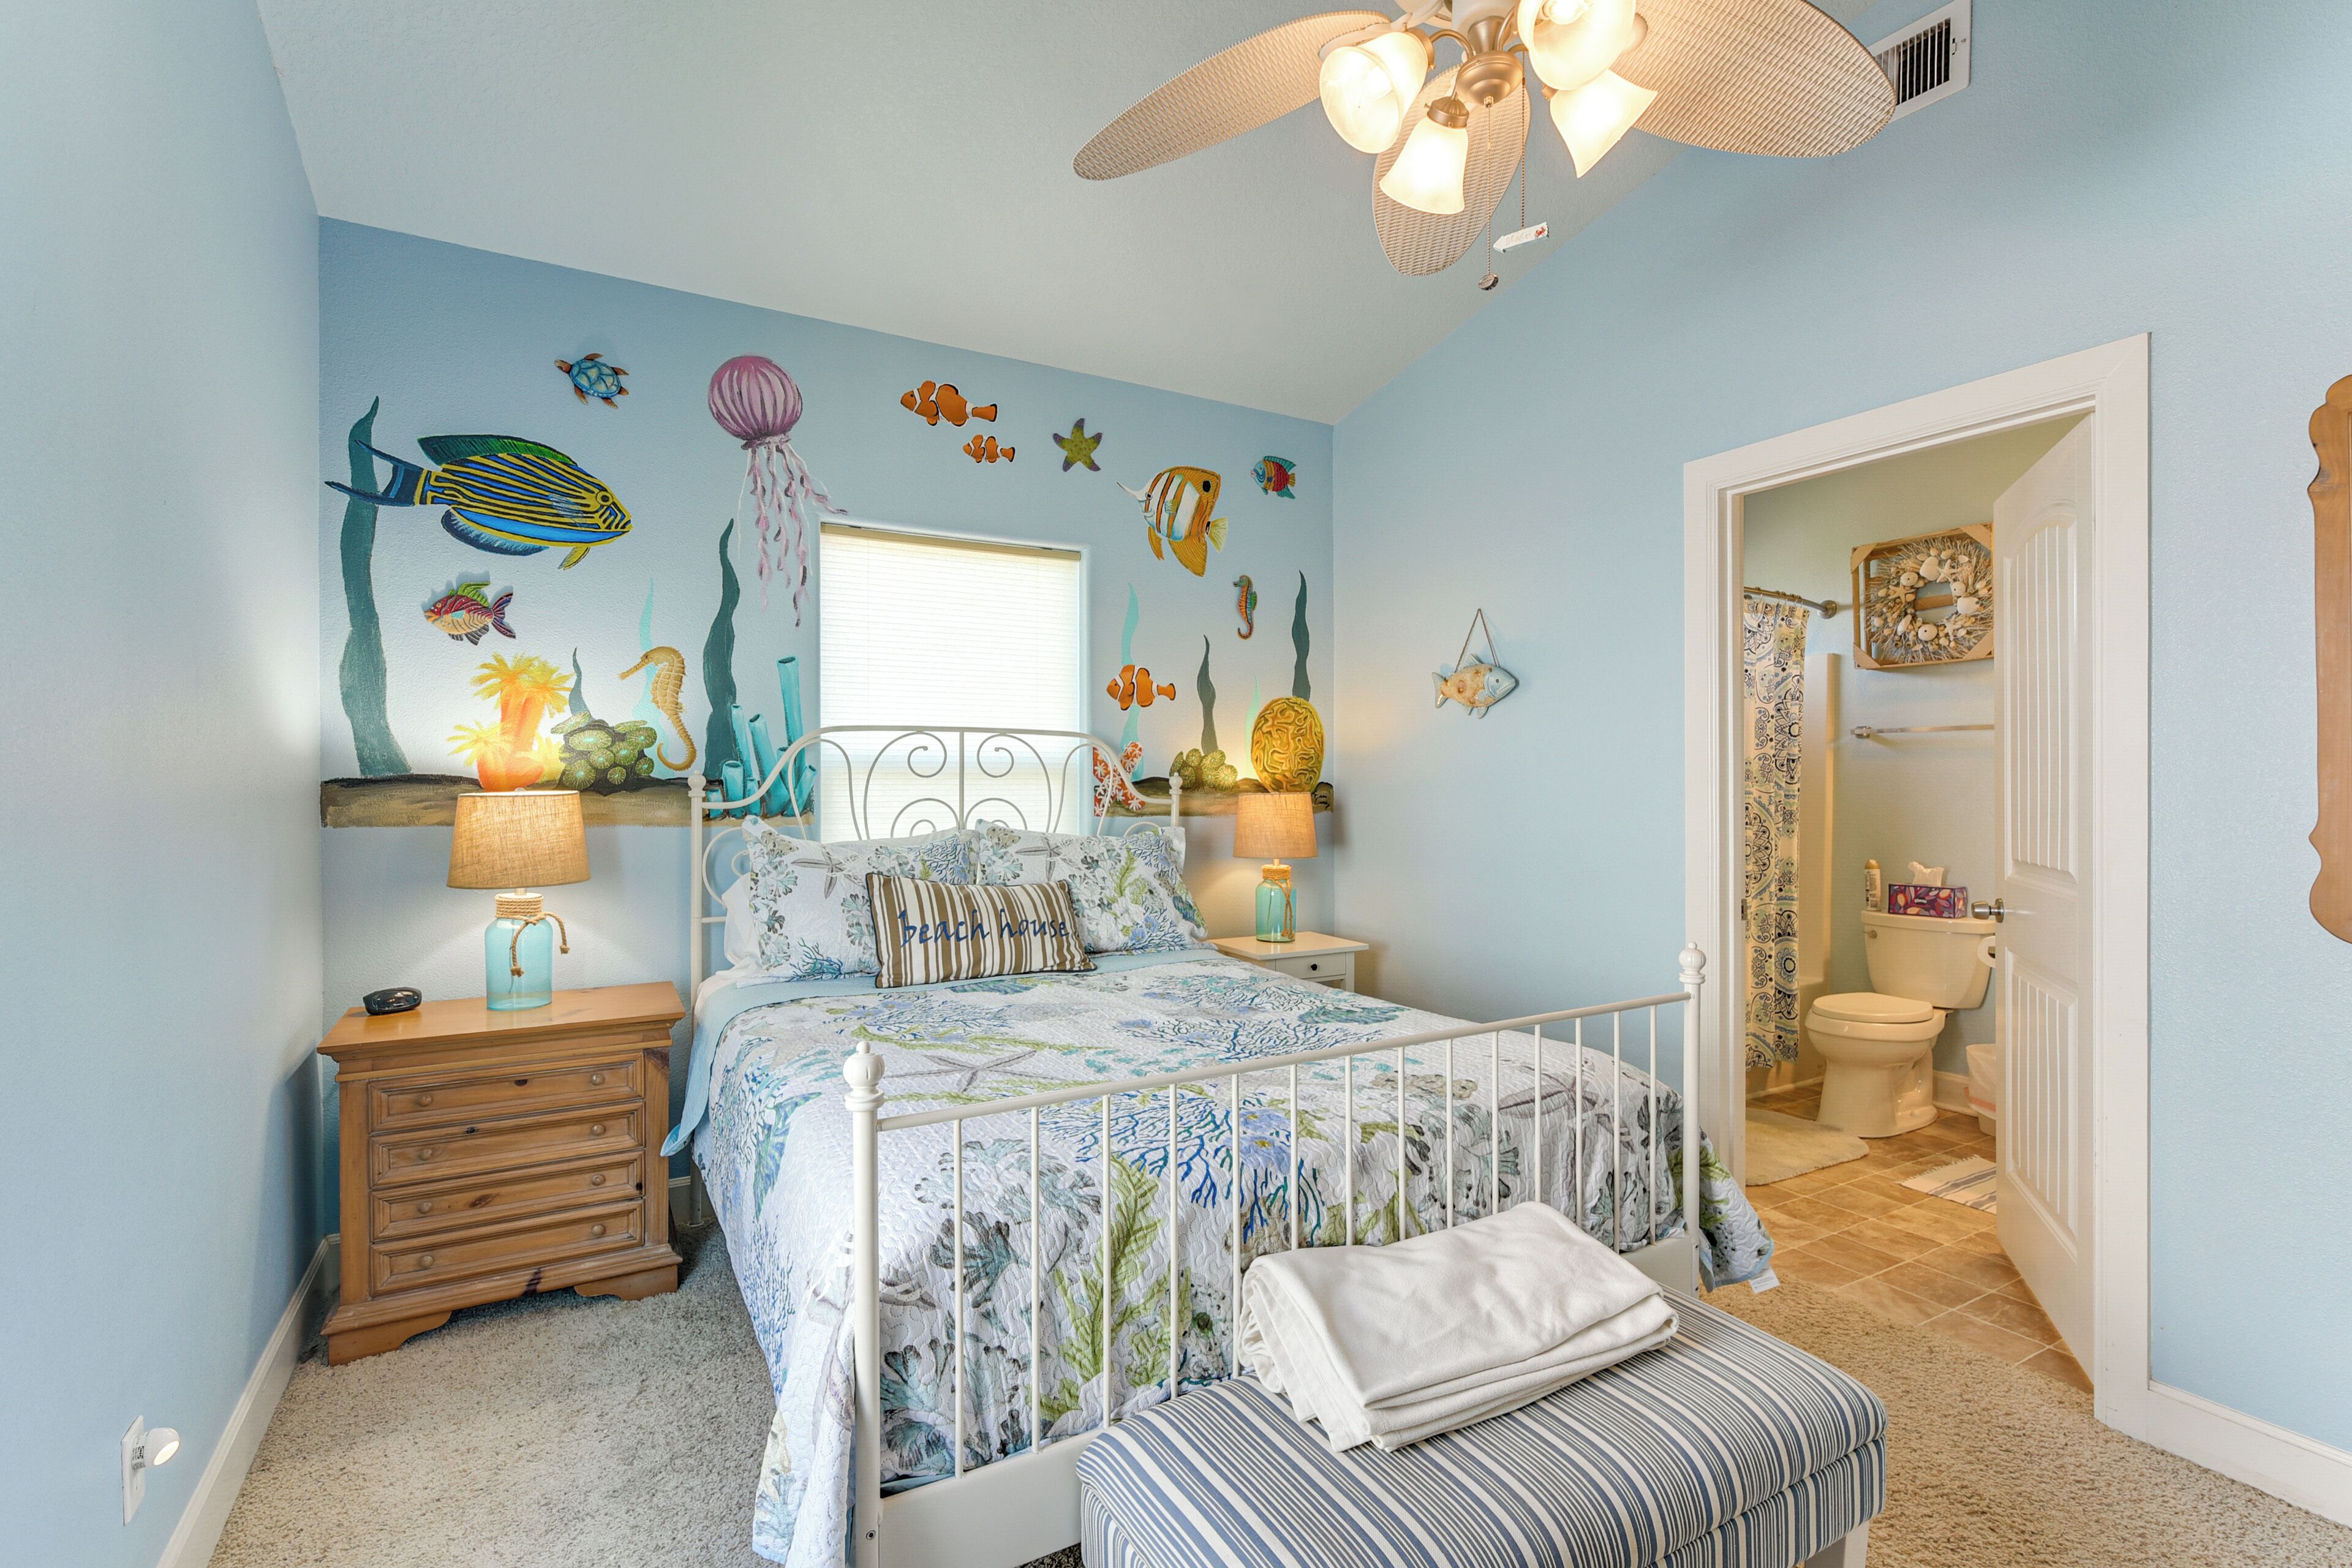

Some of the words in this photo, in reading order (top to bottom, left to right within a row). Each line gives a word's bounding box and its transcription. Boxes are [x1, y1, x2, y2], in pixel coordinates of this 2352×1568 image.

[1505, 230, 1532, 246] BEACH
[898, 909, 990, 948] beach
[1000, 908, 1070, 938] house
